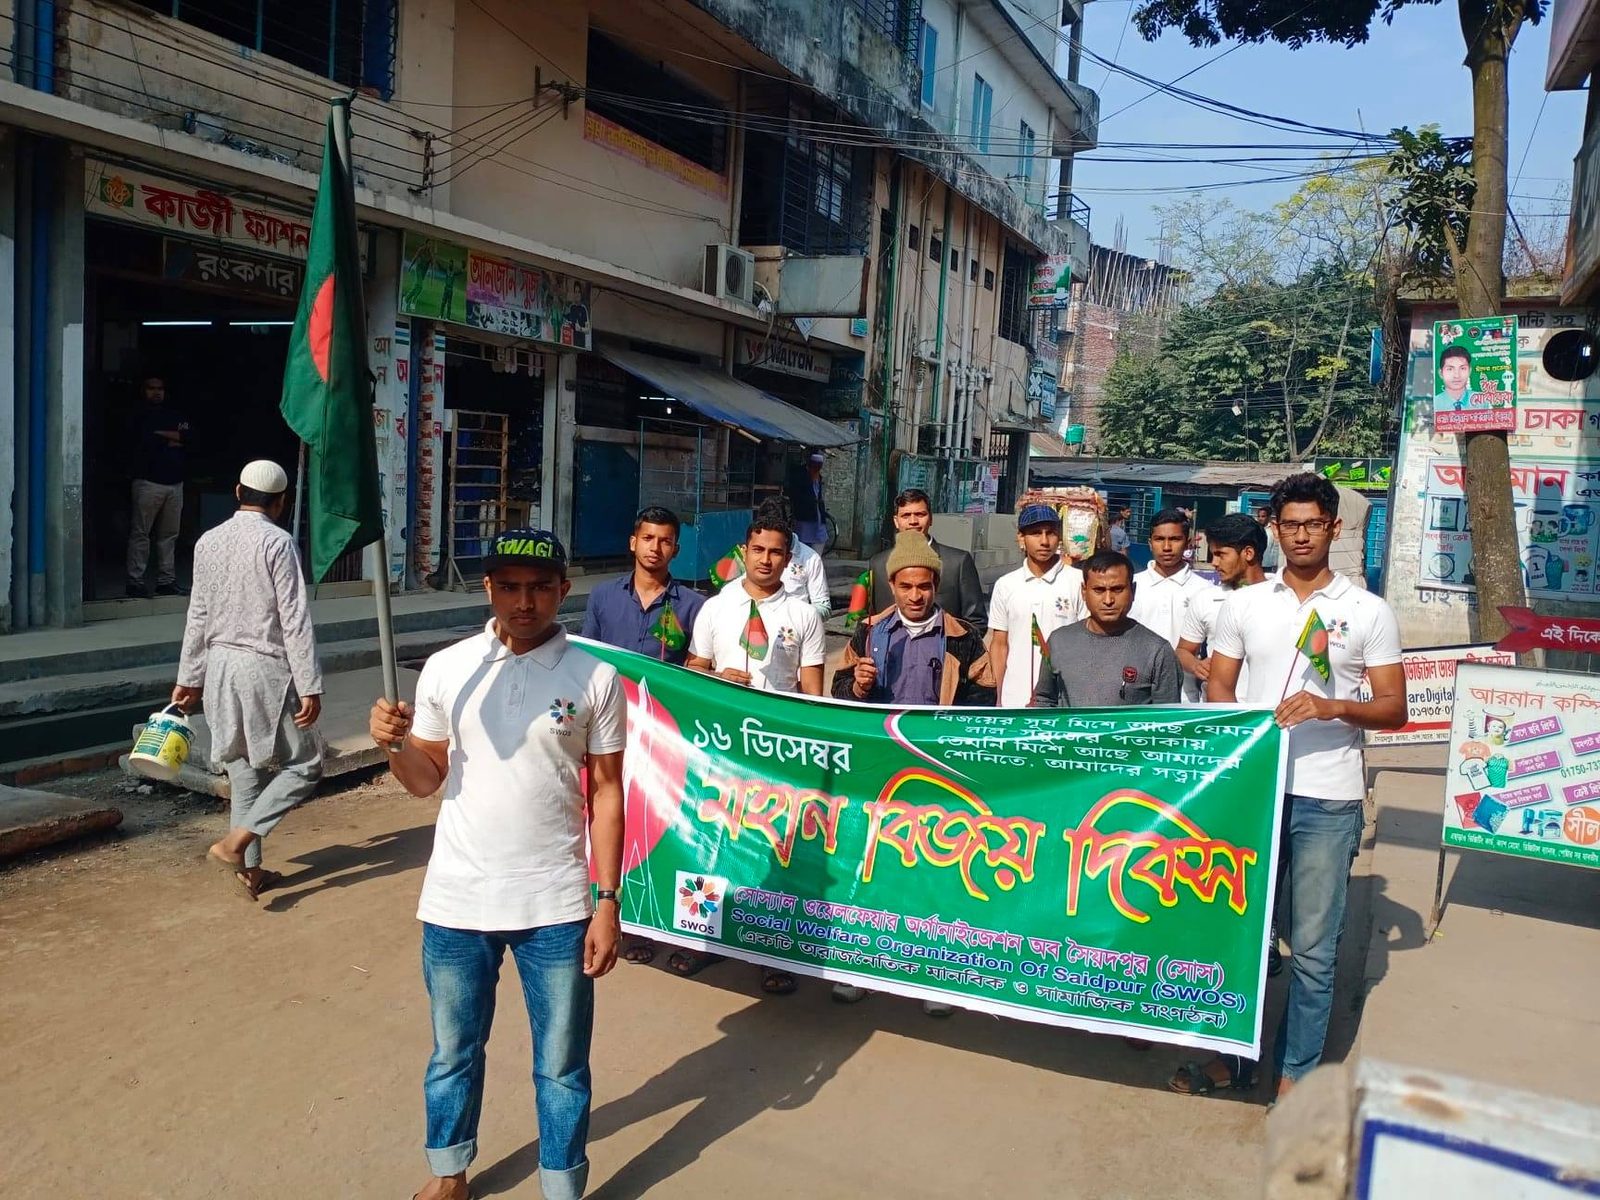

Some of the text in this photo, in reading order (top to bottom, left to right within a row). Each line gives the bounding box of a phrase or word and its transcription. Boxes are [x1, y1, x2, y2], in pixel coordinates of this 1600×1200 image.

[141, 185, 234, 234] কাজী
[769, 345, 814, 371] WALTON
[1524, 409, 1586, 430] ঢাকা
[1541, 624, 1565, 644] এই
[1426, 686, 1454, 704] Digital
[1468, 688, 1546, 710] আরমান
[549, 727, 571, 737] SWOS
[1067, 717, 1117, 730] মিশে
[693, 717, 853, 775] ১৬ ডিসেম্বর
[1014, 739, 1065, 756] মিশে
[1073, 746, 1132, 761] আছে
[1045, 758, 1144, 778] আমাদের
[1566, 807, 1600, 843] সীল
[698, 767, 1257, 923] মহান বিজয় দিবস
[680, 918, 715, 936] SWOS
[733, 885, 1225, 989] সোস্যাল ওয়েলফেয়ার অর্গানাইজেশন অব সৈয়দপুর (সোস)
[731, 908, 1247, 1014] Social Welfare Organization Of Saidpur (SWOS)
[737, 926, 793, 951] (একটি
[926, 965, 1005, 991] মানবিক
[1013, 980, 1029, 996] ও
[1036, 984, 1135, 1014] সামাজিক
